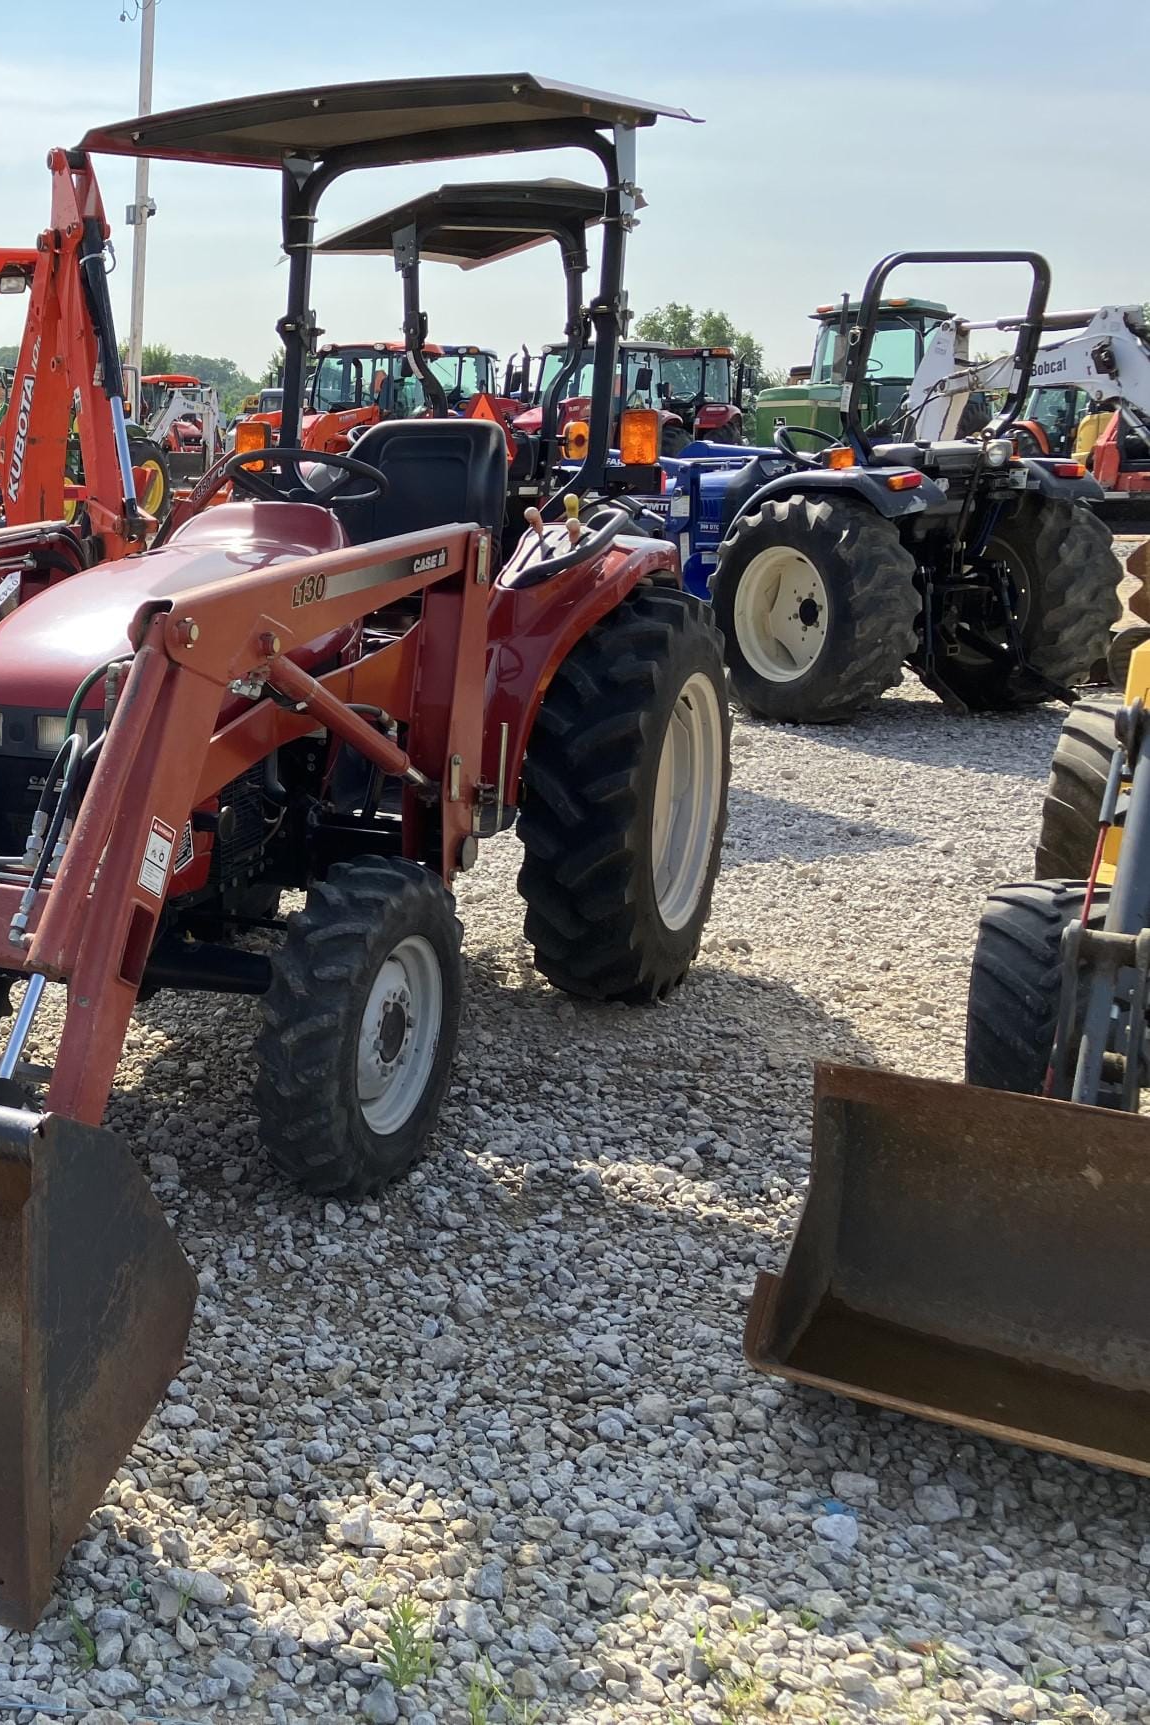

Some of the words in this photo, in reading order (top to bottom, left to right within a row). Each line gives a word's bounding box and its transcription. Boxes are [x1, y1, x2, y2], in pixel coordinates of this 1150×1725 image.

[1031, 357, 1066, 377] Bobcat
[7, 375, 36, 502] KUBOTA
[292, 573, 326, 608] L130
[413, 554, 438, 573] CASE
[29, 775, 65, 786] CAE
